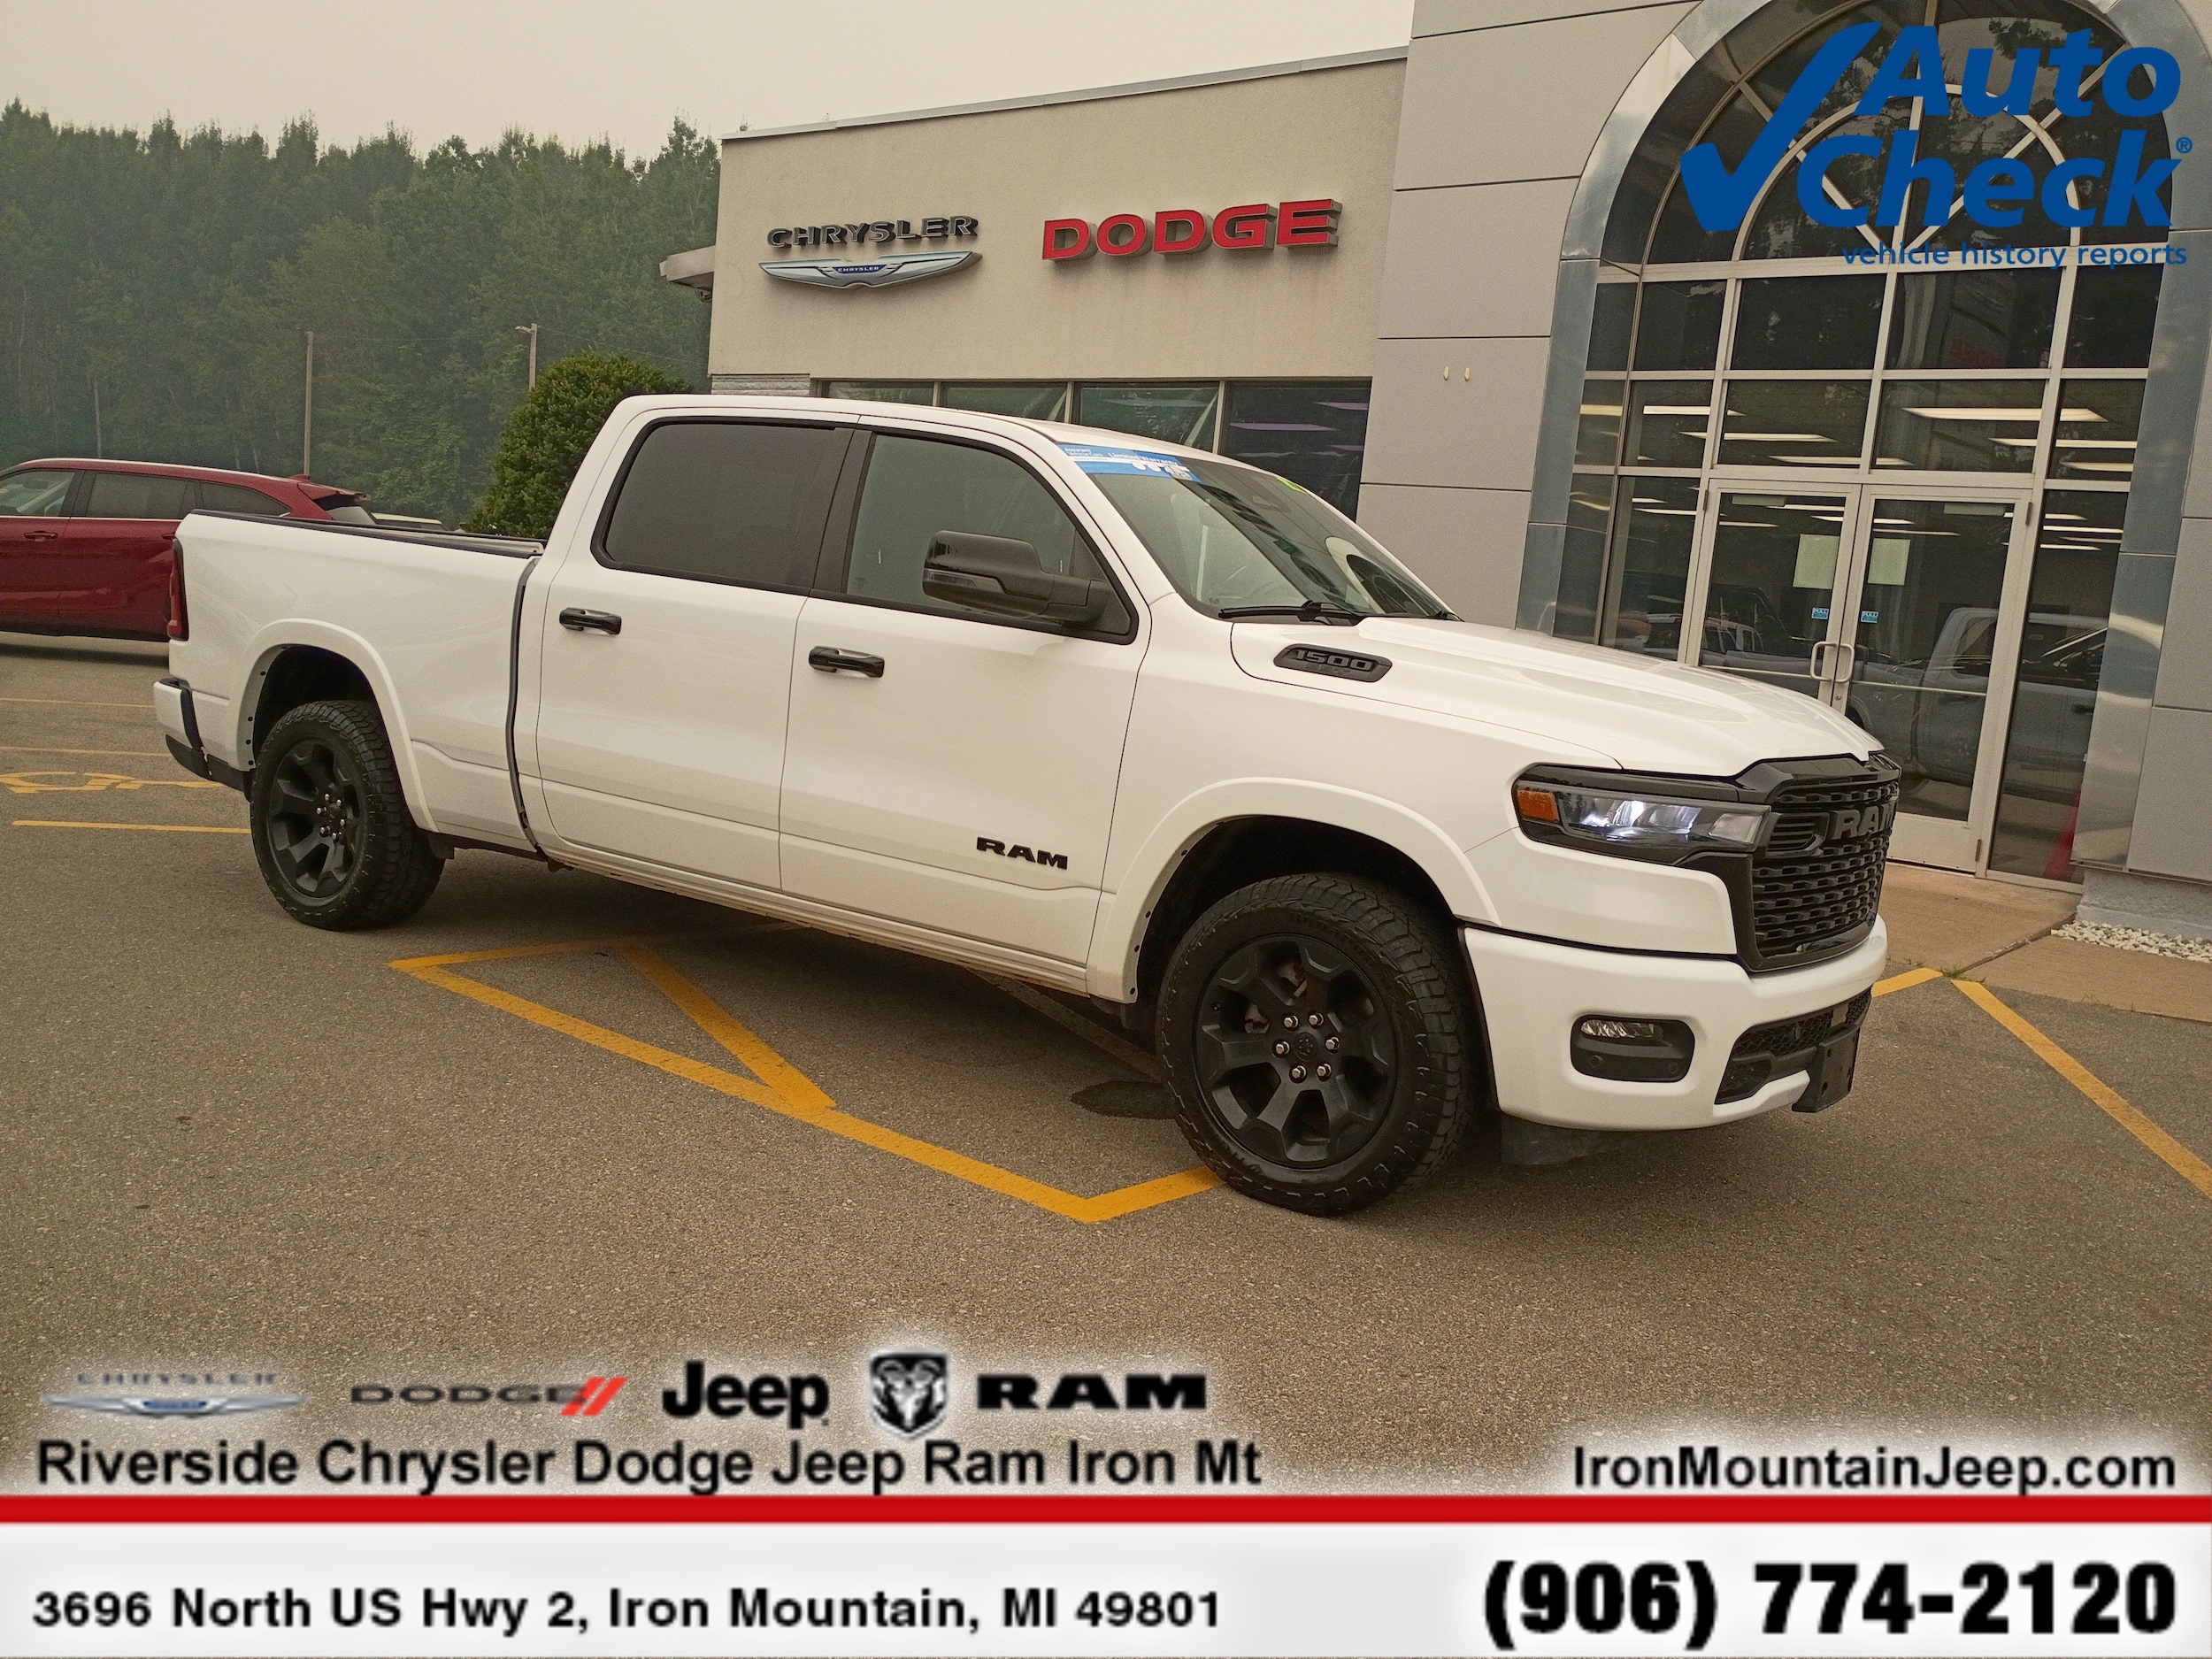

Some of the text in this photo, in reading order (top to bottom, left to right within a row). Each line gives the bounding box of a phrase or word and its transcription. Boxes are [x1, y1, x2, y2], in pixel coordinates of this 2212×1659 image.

[766, 215, 979, 249] CHRYSLER
[1042, 198, 1342, 261] DODGE
[837, 265, 880, 273] CHRYSLER
[1295, 649, 1372, 672] 1500
[1832, 802, 1895, 841] RAM
[976, 836, 1068, 871] RAM
